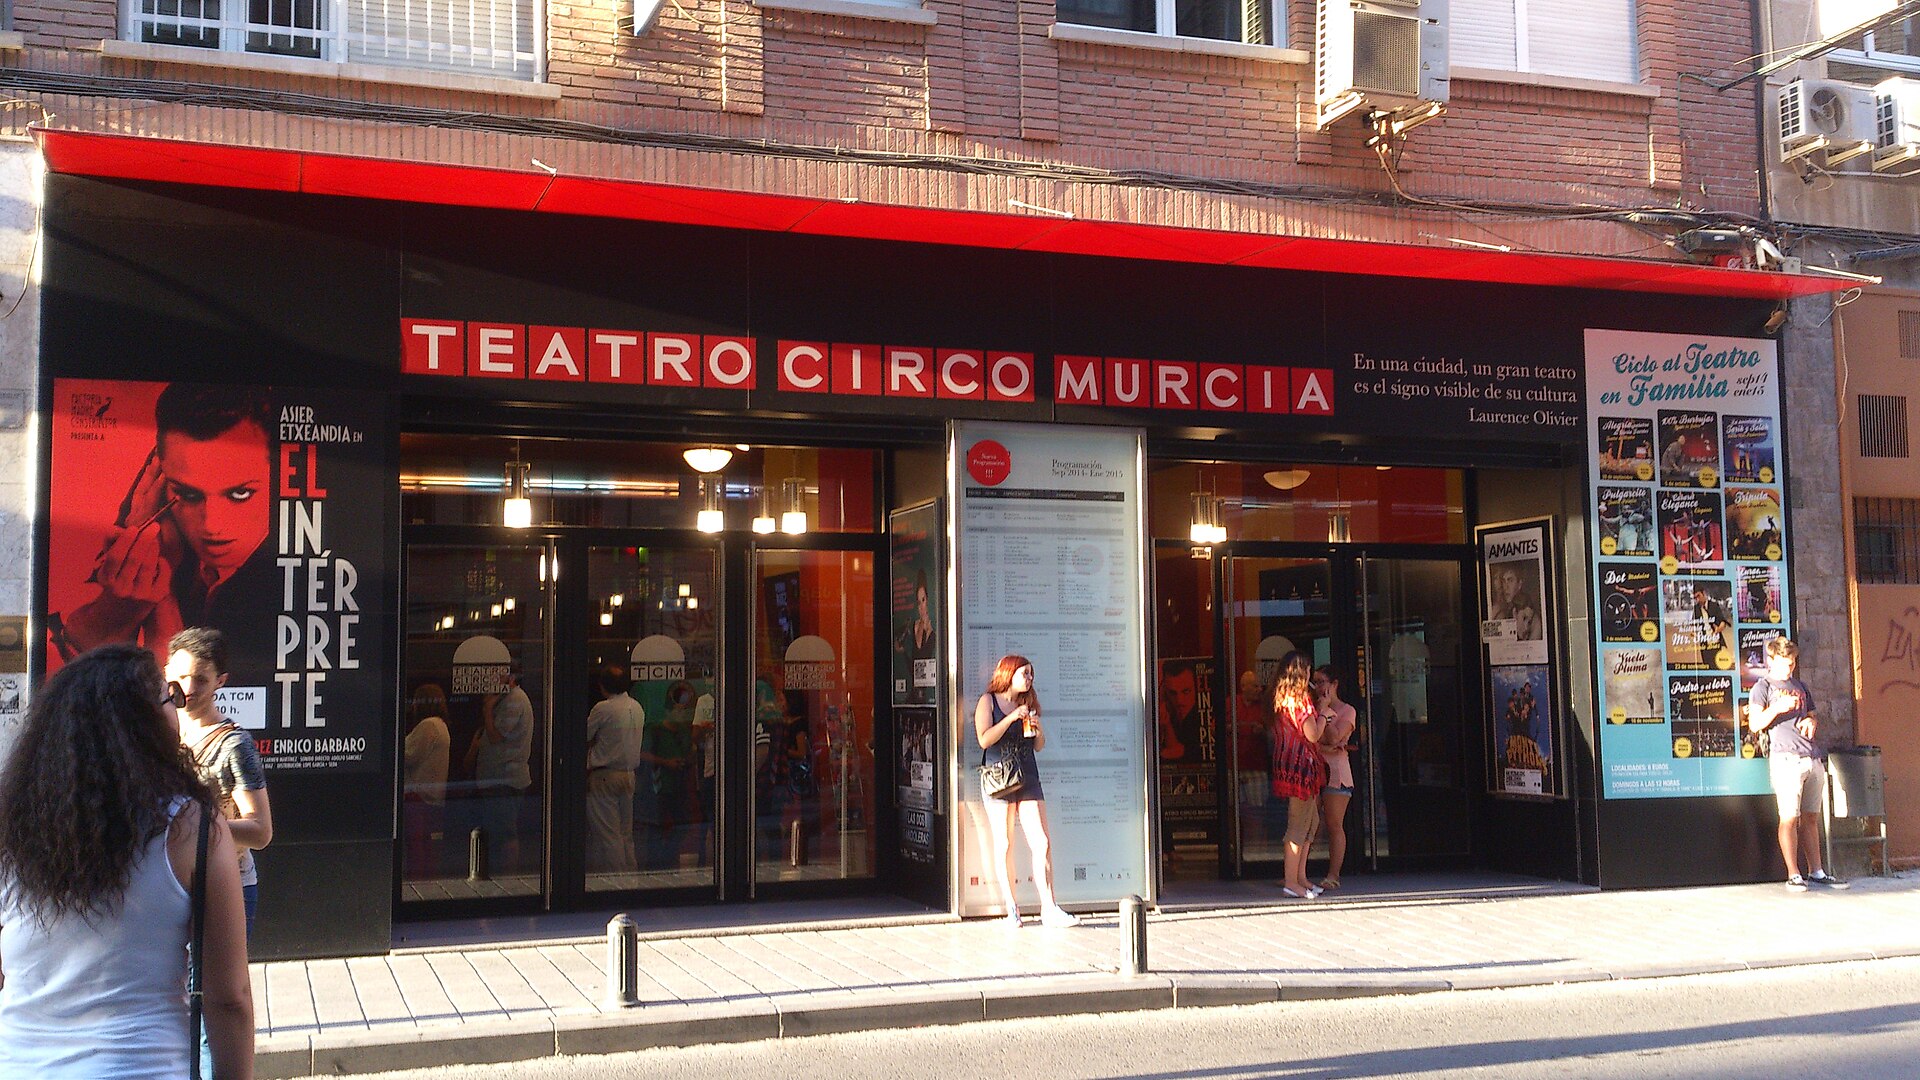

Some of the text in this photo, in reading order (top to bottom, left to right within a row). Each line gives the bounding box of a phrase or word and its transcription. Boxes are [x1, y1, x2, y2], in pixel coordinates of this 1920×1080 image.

[1353, 353, 1576, 380] En una ciudad, un gran teatro
[1612, 343, 1761, 374] Ciclo al Teatro
[412, 325, 1330, 411] TEATRO CIRCO MURCIA
[1353, 379, 1577, 403] es el signo visible de su cultura
[1600, 373, 1730, 406] en Familia
[279, 405, 314, 424] ASIER
[1469, 407, 1578, 426] Laurence Olivier
[279, 423, 363, 443] ETXEANDIA EN
[279, 443, 327, 497] EL
[1052, 458, 1102, 470] Programación
[1052, 468, 1066, 478] Sep
[1089, 470, 1104, 478] Ene
[1661, 498, 1699, 513] Elegance
[278, 500, 322, 555] IN
[1488, 539, 1538, 559] AMANTES
[276, 550, 359, 612] TÉR
[1604, 570, 1627, 585] Dot
[276, 615, 360, 670] PRE
[1618, 652, 1646, 663] Vuela
[454, 667, 509, 675] TEATRO
[633, 667, 683, 679] TCM
[1613, 663, 1648, 675] Pluma
[454, 685, 509, 693] MURCIA
[1670, 681, 1699, 695] Pedro
[1712, 677, 1731, 690] lobo
[230, 692, 254, 701] TCM
[274, 672, 326, 728] TE
[1198, 692, 1211, 710] IN
[230, 706, 240, 715] h.
[273, 739, 312, 754] ENRICO
[314, 737, 366, 753] BARBARO
